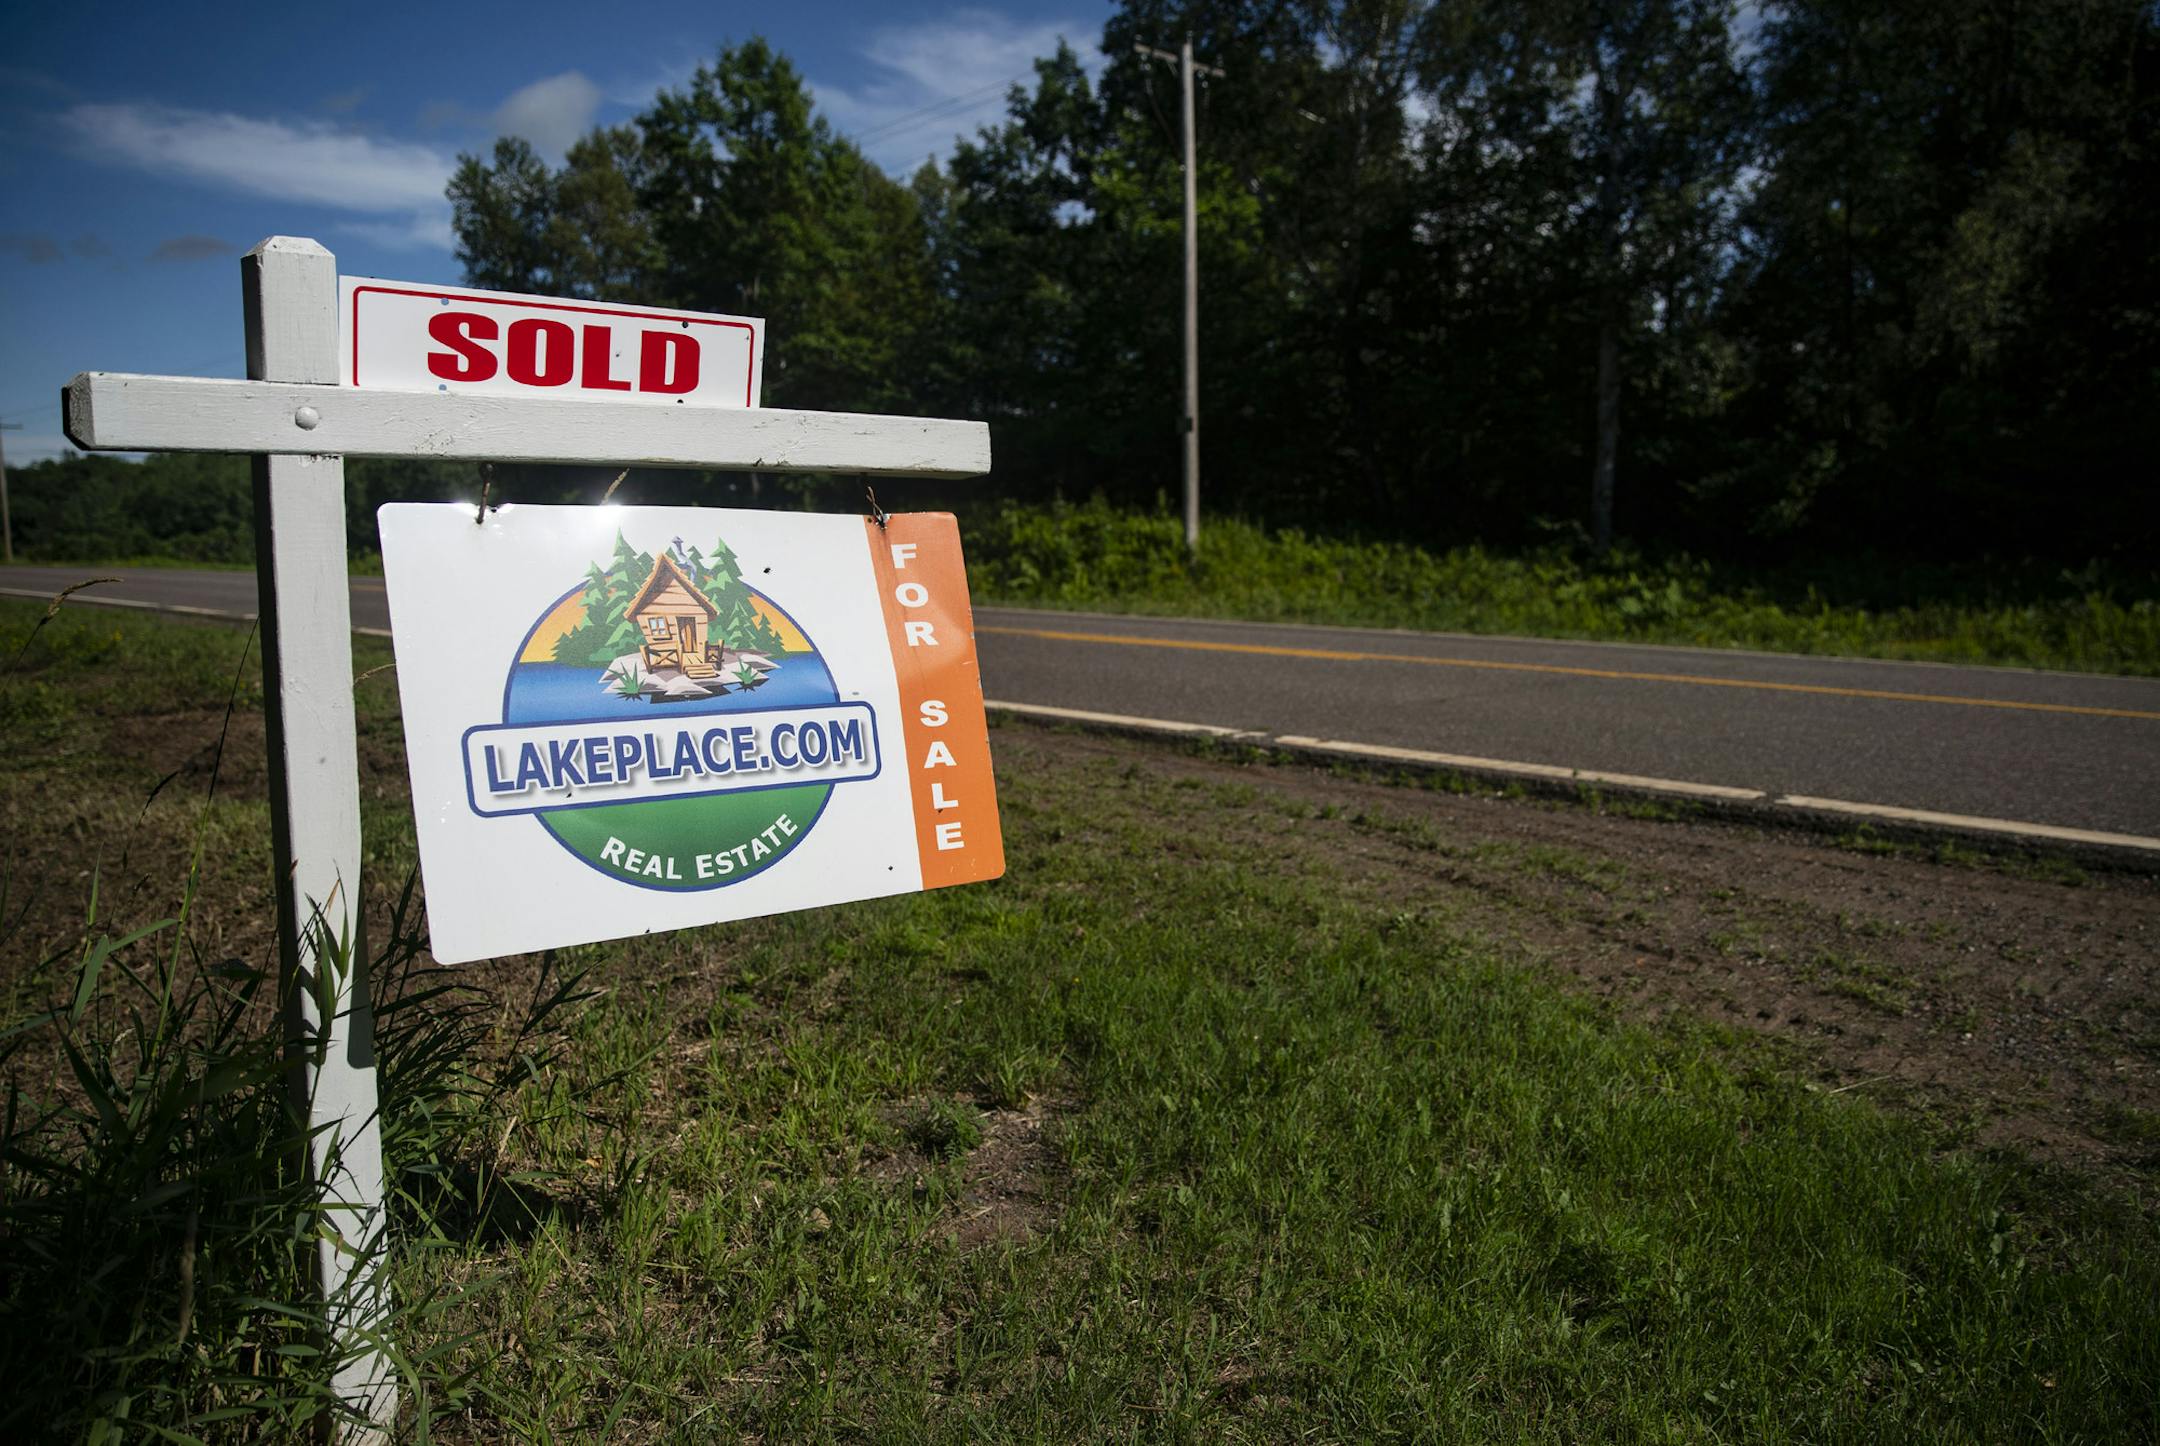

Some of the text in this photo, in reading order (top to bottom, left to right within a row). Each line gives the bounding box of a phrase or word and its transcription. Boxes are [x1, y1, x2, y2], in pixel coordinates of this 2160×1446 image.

[427, 311, 701, 394] SOLD
[890, 543, 965, 851] FOR SALE
[483, 718, 864, 793] LAKEPLACE.COM
[600, 813, 799, 881] REAL ESTATE
